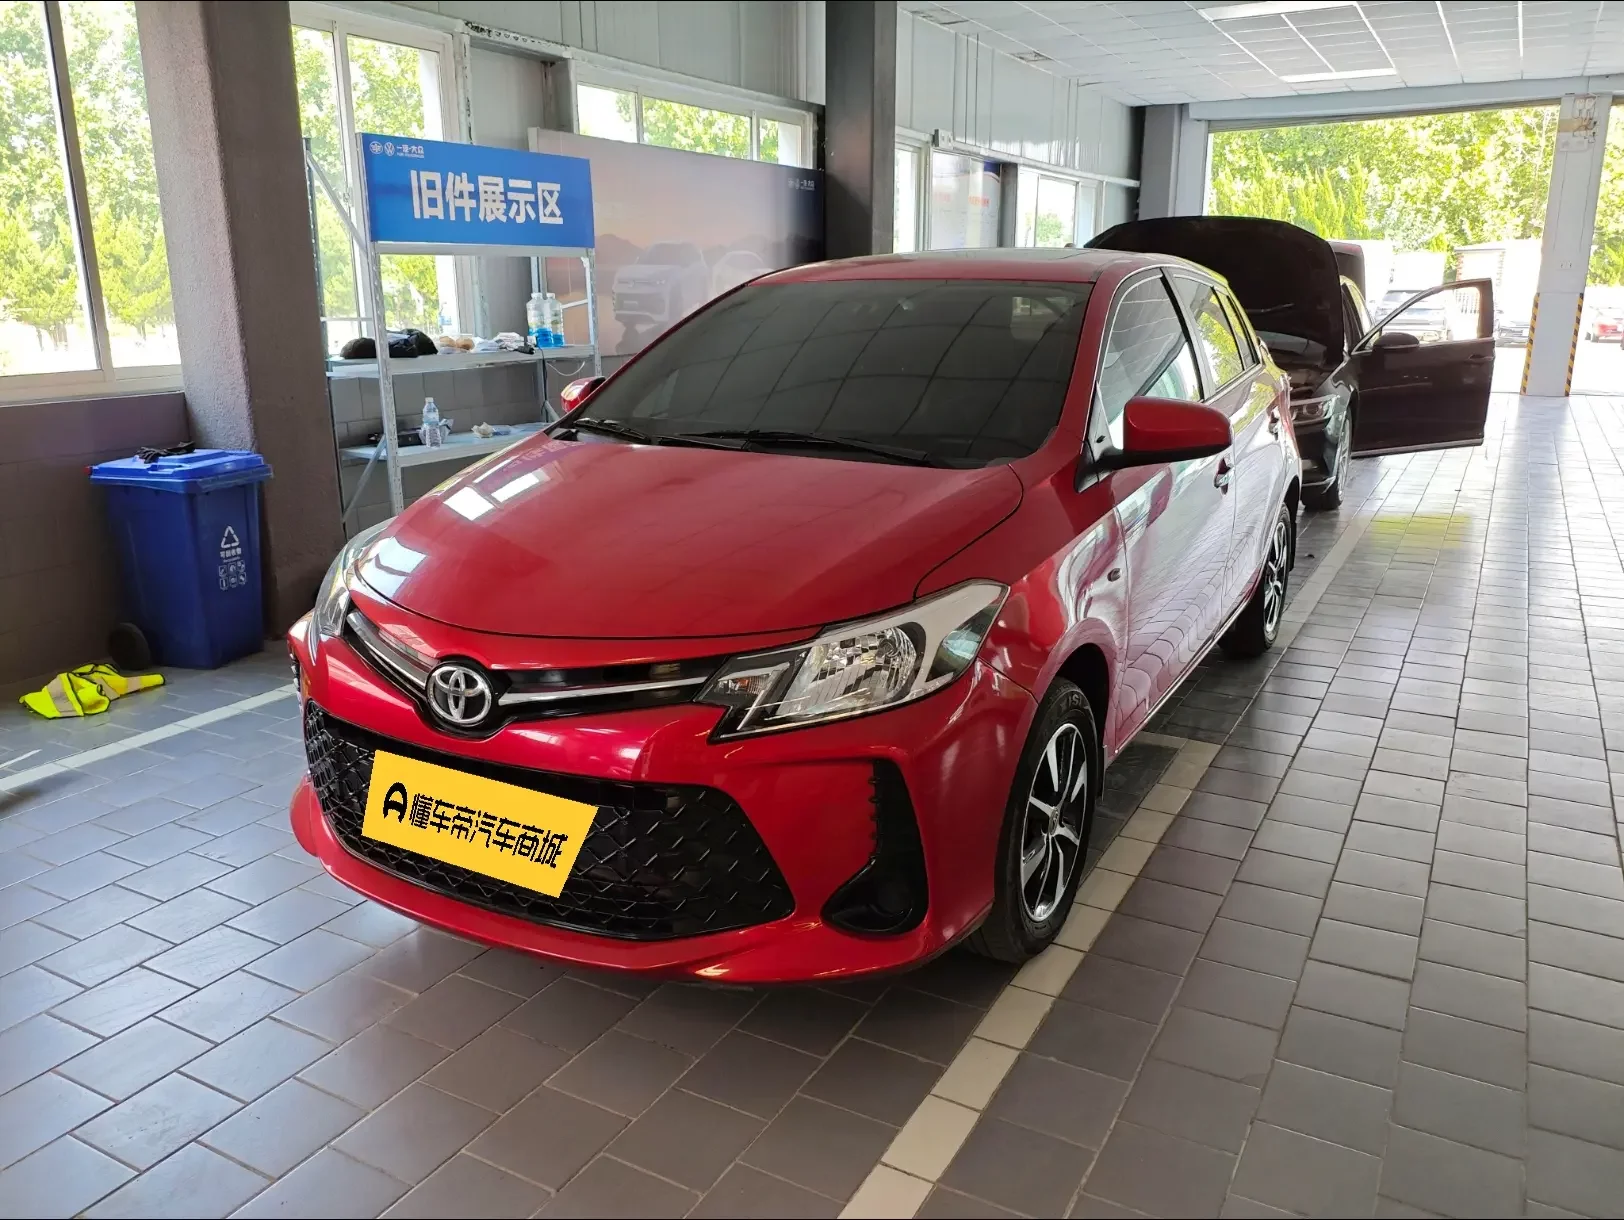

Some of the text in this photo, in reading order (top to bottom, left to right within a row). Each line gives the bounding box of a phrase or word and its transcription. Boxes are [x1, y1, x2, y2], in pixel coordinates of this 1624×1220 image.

[410, 169, 563, 225] 旧件展示区
